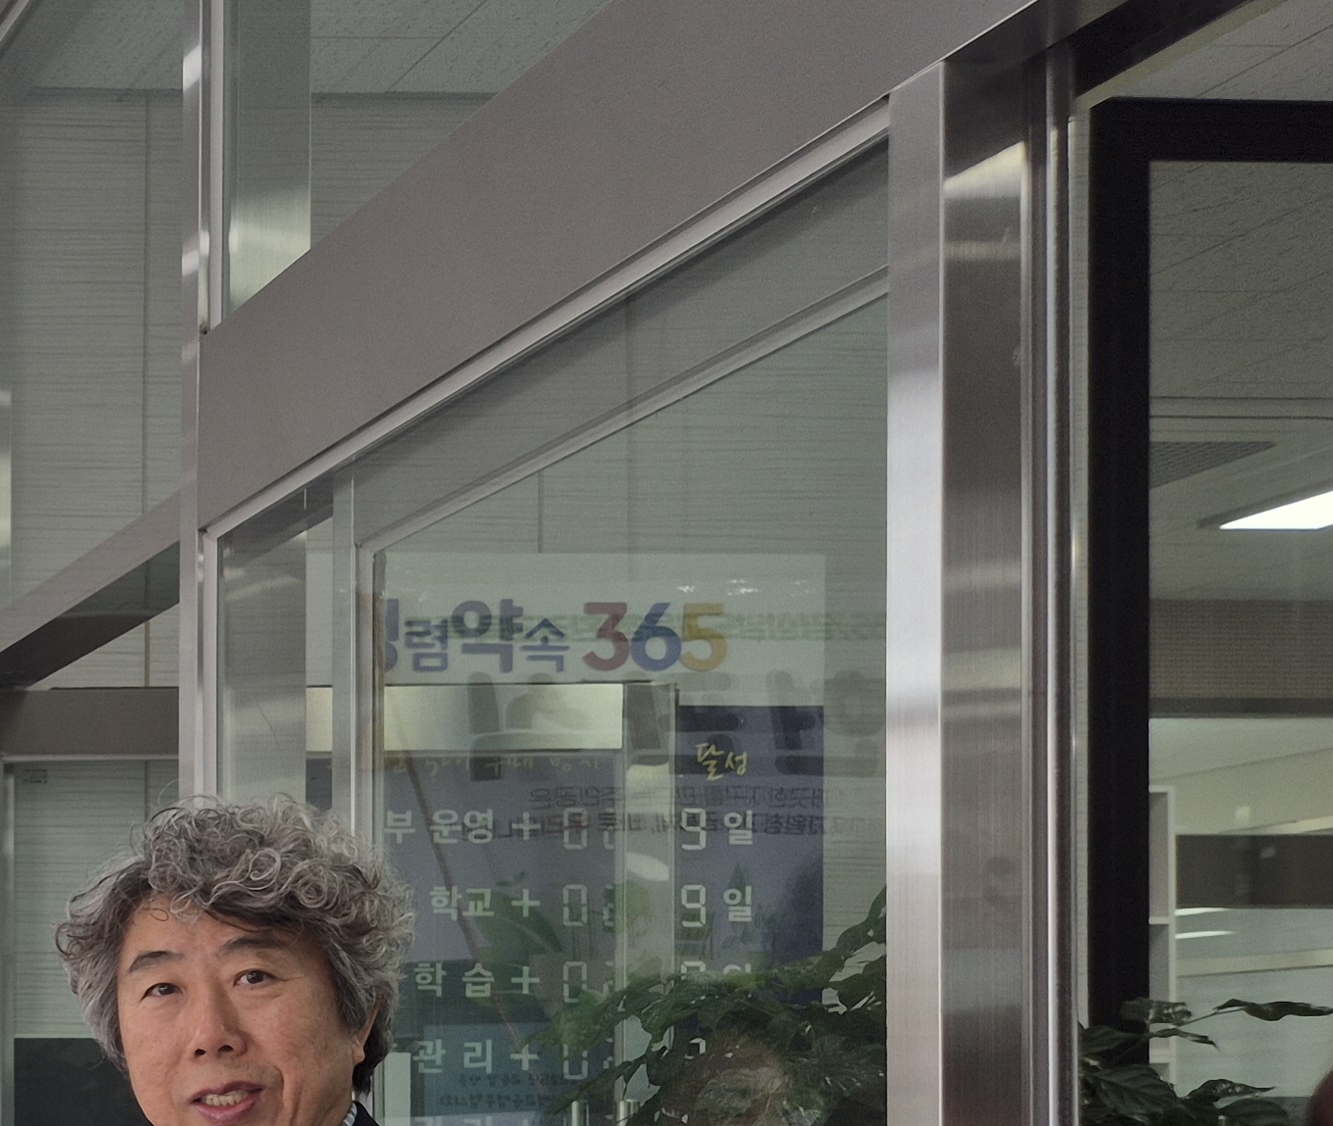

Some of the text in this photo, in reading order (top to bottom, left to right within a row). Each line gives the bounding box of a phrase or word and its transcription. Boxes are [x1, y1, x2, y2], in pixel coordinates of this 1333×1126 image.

[582, 602, 727, 671] 365
[430, 808, 494, 844] 운영
[429, 884, 495, 921] 학교
